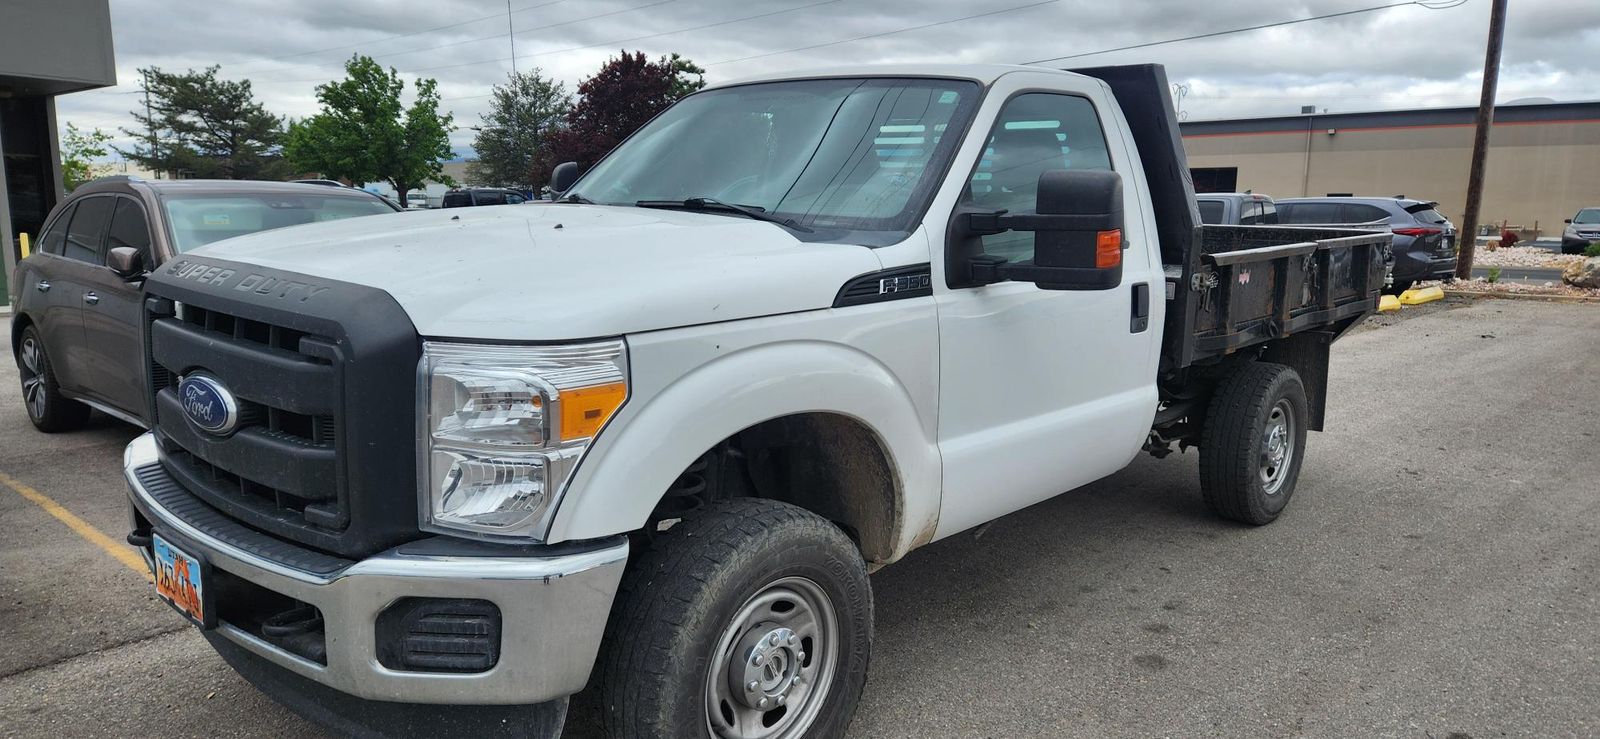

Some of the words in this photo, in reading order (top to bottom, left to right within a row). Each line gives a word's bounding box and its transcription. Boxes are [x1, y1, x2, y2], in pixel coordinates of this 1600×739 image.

[166, 260, 235, 286] SUPER
[235, 274, 331, 302] DUTY
[184, 385, 213, 421] Ford
